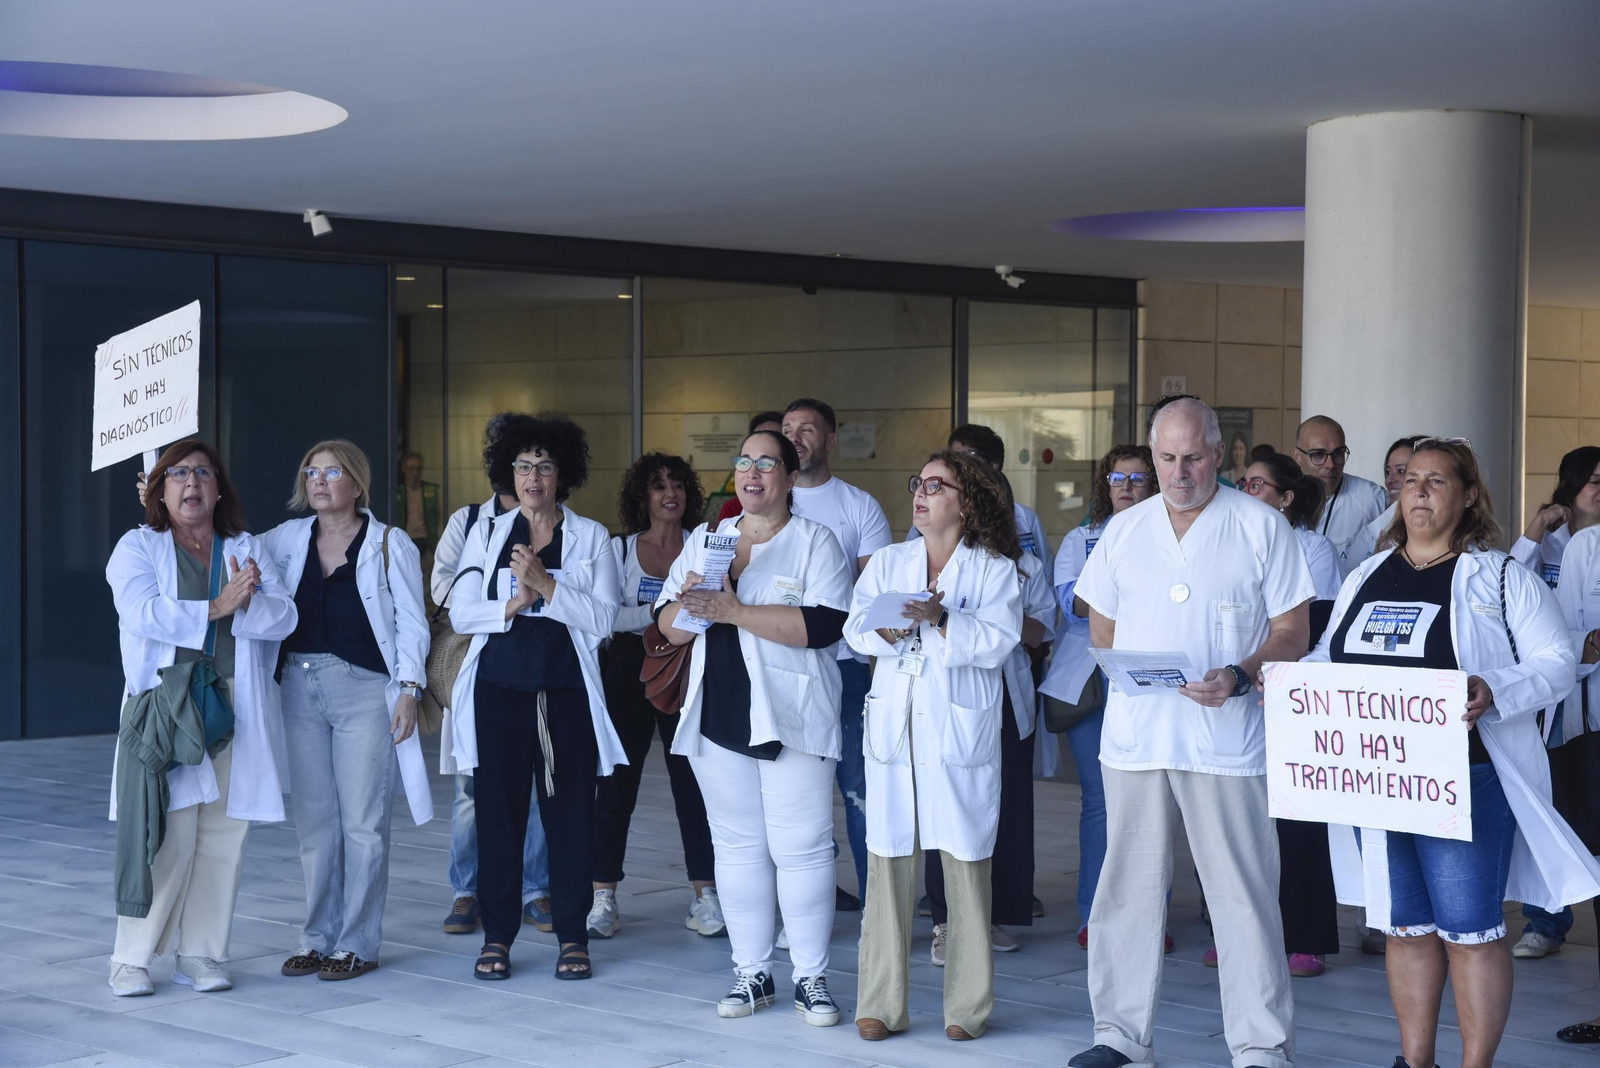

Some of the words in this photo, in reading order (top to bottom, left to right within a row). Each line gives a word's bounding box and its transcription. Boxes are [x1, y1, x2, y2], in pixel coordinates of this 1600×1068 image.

[112, 353, 139, 380] SIN
[142, 330, 193, 367] TÉCNICOS
[123, 389, 138, 407] NO
[145, 378, 166, 401] HAY
[100, 406, 173, 447] DIAGNÓSTICO
[1365, 621, 1397, 634] HUELGA
[1397, 621, 1413, 635] TSS
[1167, 678, 1185, 686] TSS
[1288, 682, 1330, 716] SIN
[1337, 686, 1447, 726] TÉCNICOS
[1314, 730, 1344, 756] NO
[1360, 732, 1406, 763] HAY
[1285, 762, 1457, 805] TRATAMIENTOS
